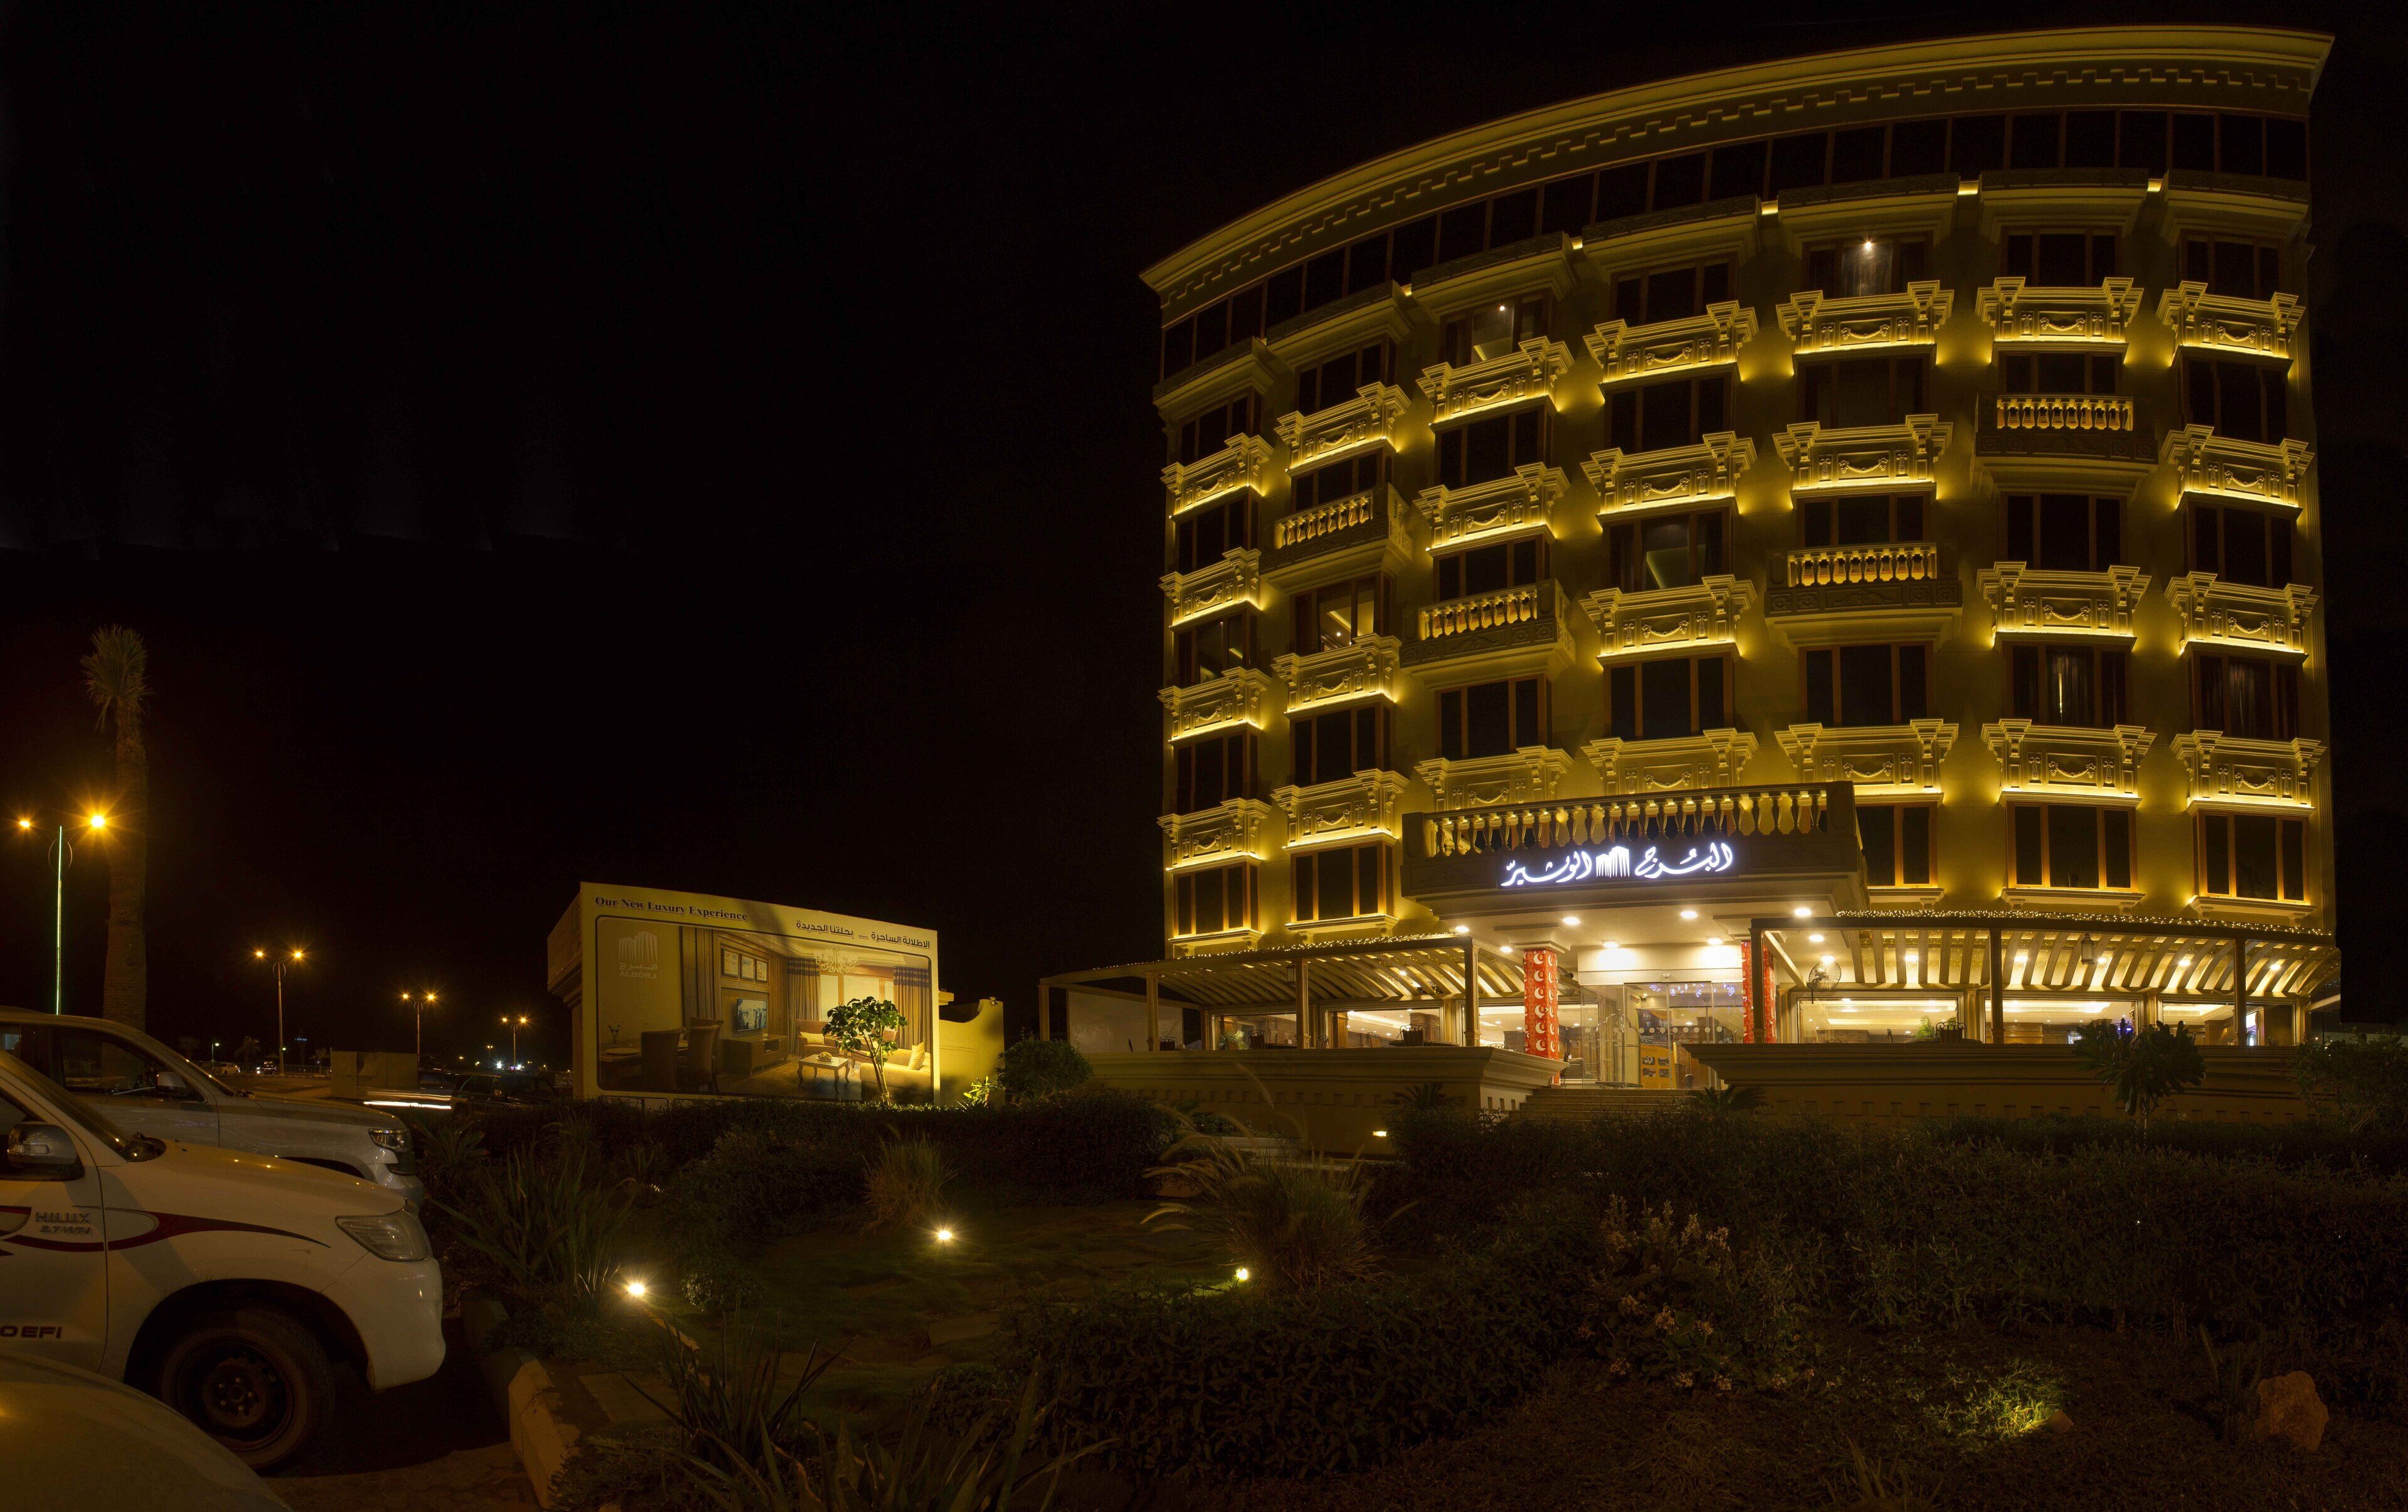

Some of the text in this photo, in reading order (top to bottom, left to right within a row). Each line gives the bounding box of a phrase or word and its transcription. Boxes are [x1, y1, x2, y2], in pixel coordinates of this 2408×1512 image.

[595, 897, 749, 921] Our New Luxury Experience
[796, 920, 828, 934] الجديدة
[871, 931, 901, 943] الساحرة
[36, 1212, 91, 1224] HILUX
